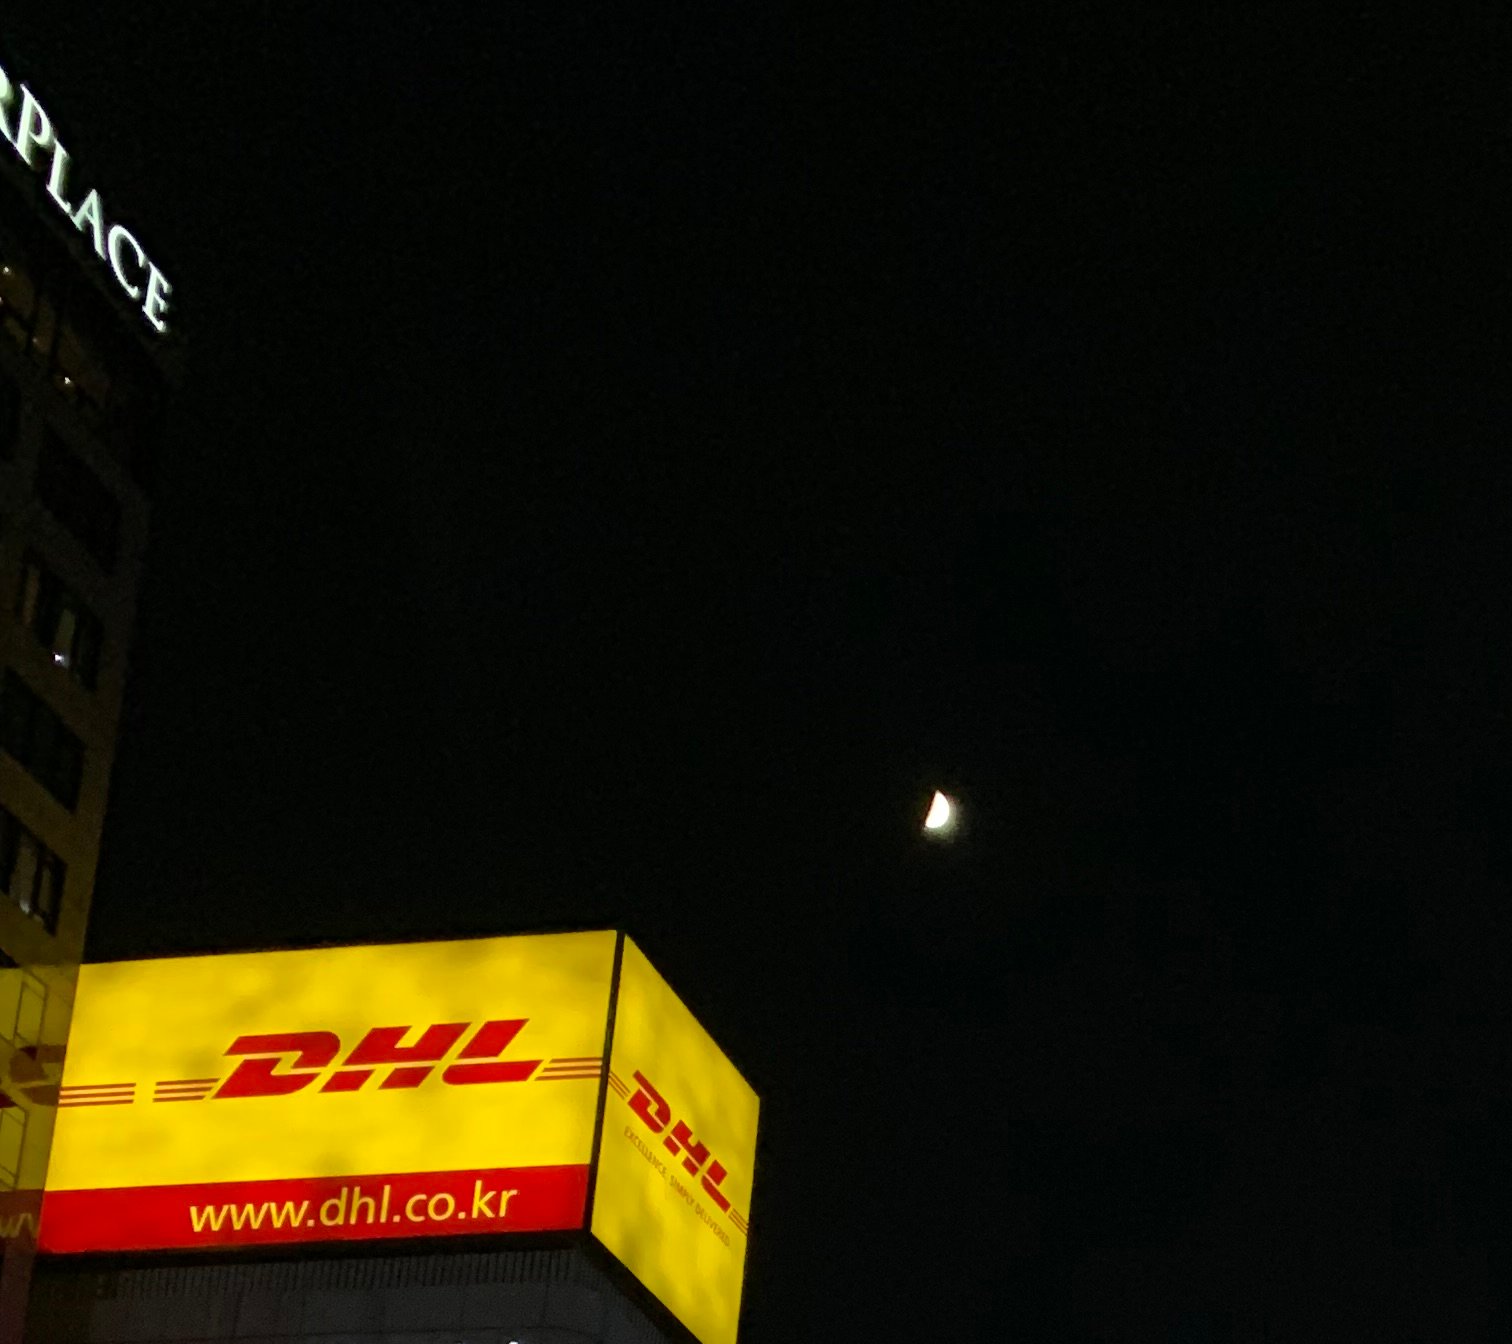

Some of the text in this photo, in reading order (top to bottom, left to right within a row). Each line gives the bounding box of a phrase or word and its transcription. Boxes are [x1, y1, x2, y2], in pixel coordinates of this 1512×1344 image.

[213, 1018, 544, 1099] DHL
[627, 1070, 732, 1213] DHL
[189, 1179, 518, 1233] www.dhl.co.kr
